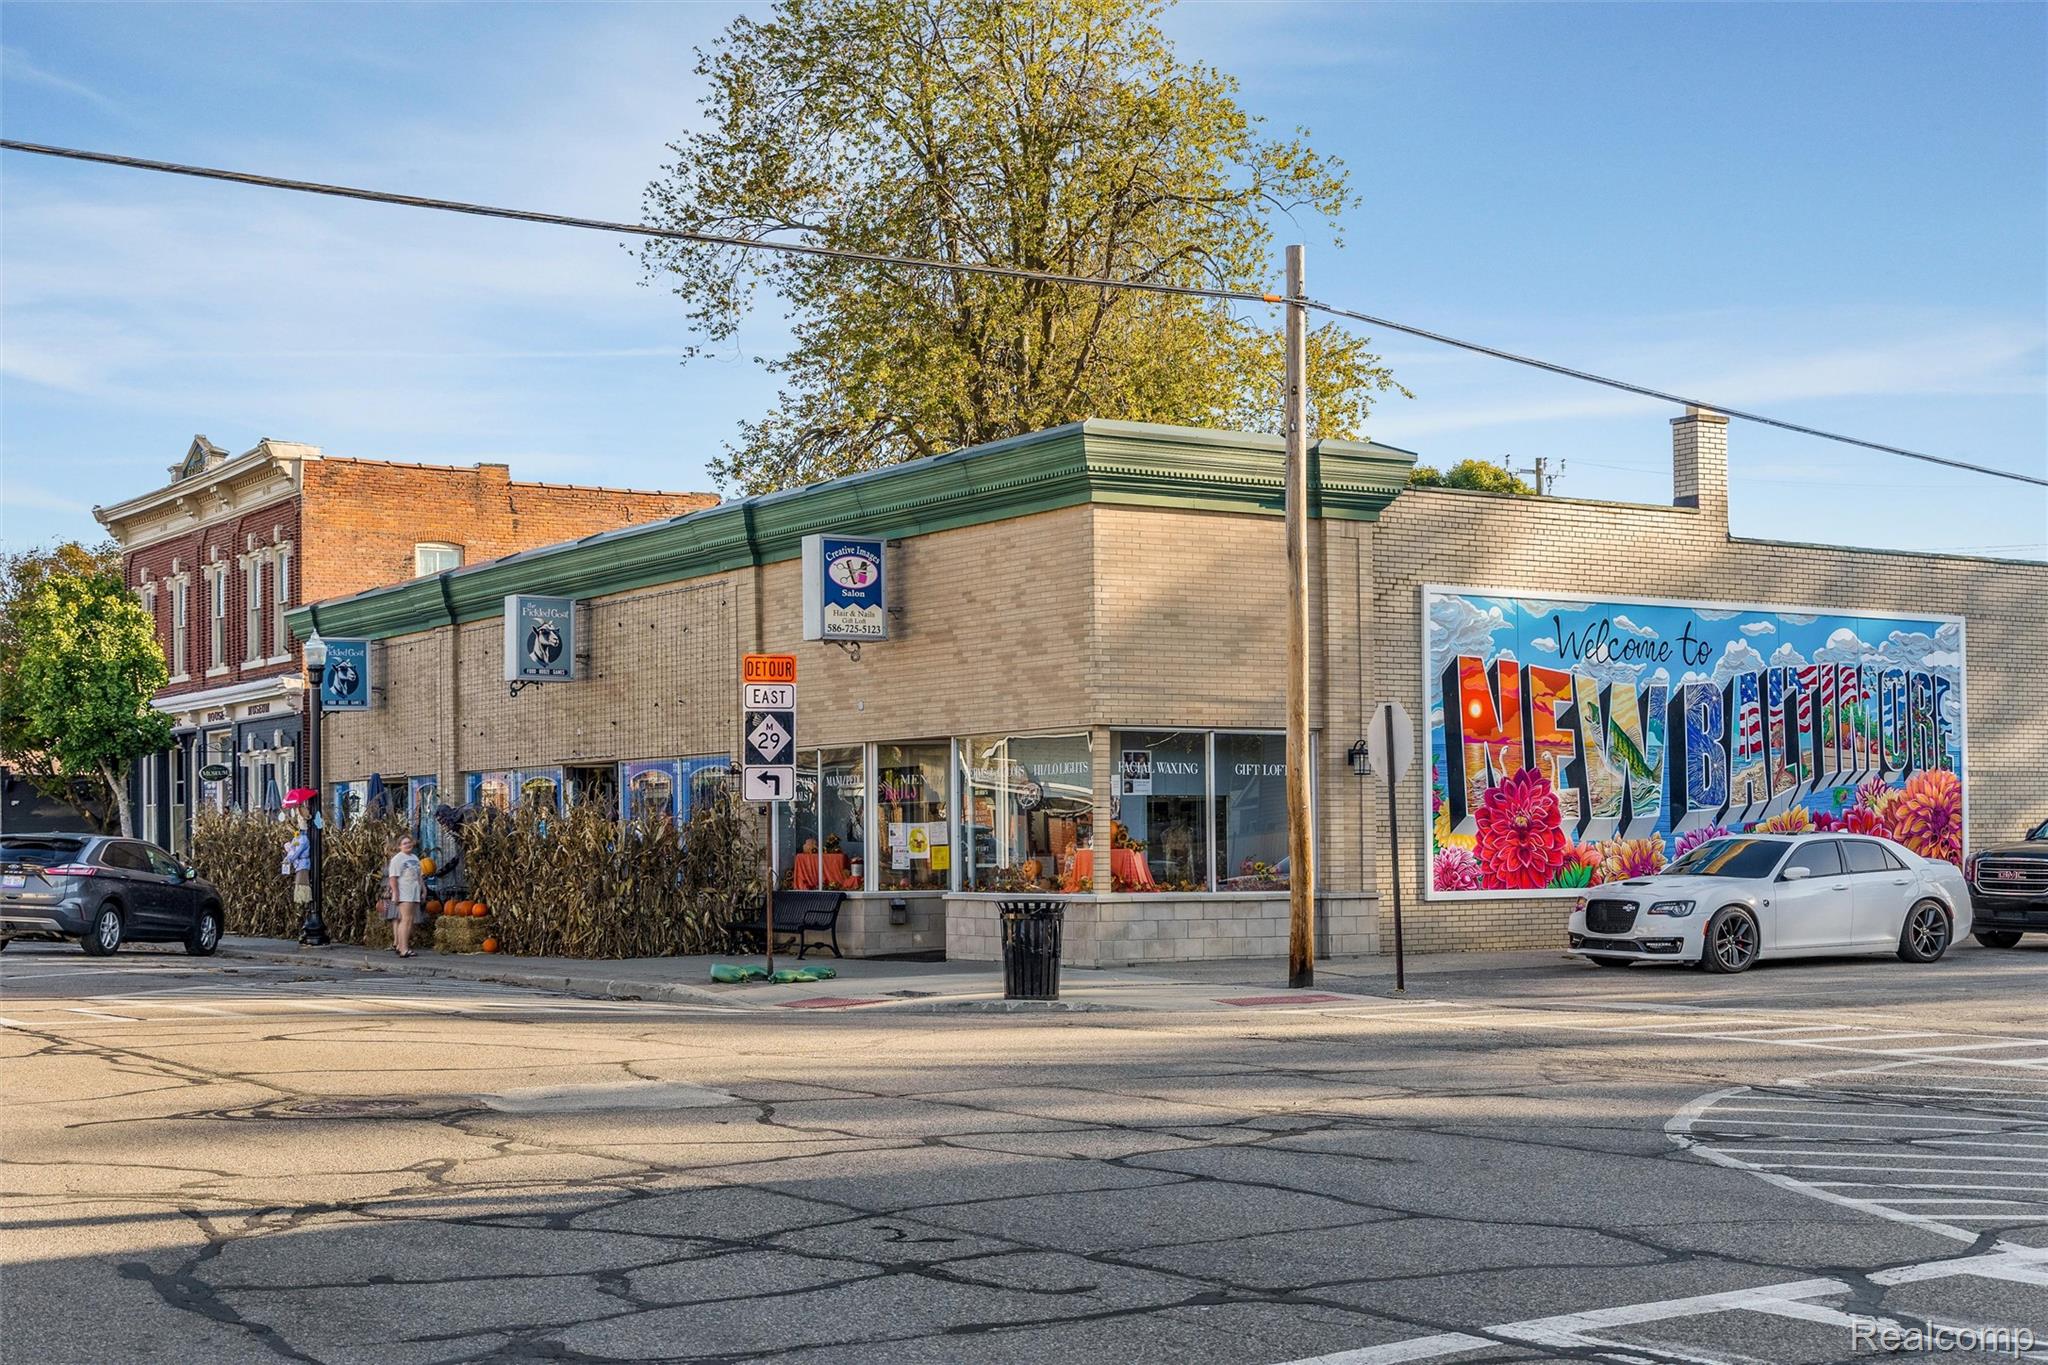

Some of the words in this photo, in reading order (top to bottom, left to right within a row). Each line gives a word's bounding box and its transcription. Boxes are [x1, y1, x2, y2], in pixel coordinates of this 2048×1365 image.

[825, 545, 855, 562] Creative
[856, 546, 880, 565] Images
[841, 589, 866, 598] Salon
[832, 609, 848, 617] Hair
[858, 610, 876, 618] Nails
[827, 624, 881, 634] 586-725-5123
[1553, 614, 1673, 664] Welcome
[1675, 620, 1713, 666] to
[747, 661, 792, 677] DETOUR
[753, 689, 786, 704] EAST
[247, 703, 270, 716] MUSEUM
[765, 723, 774, 731] M
[758, 732, 780, 750] 29
[1446, 655, 1669, 830] NEW
[1674, 662, 1954, 822] BALTIMORE
[1059, 761, 1089, 775] LIGHTS
[1118, 761, 1154, 774] FACIAL
[1156, 761, 1198, 775] WAXING
[1234, 763, 1261, 776] GIFT
[1998, 870, 2027, 880] GMC
